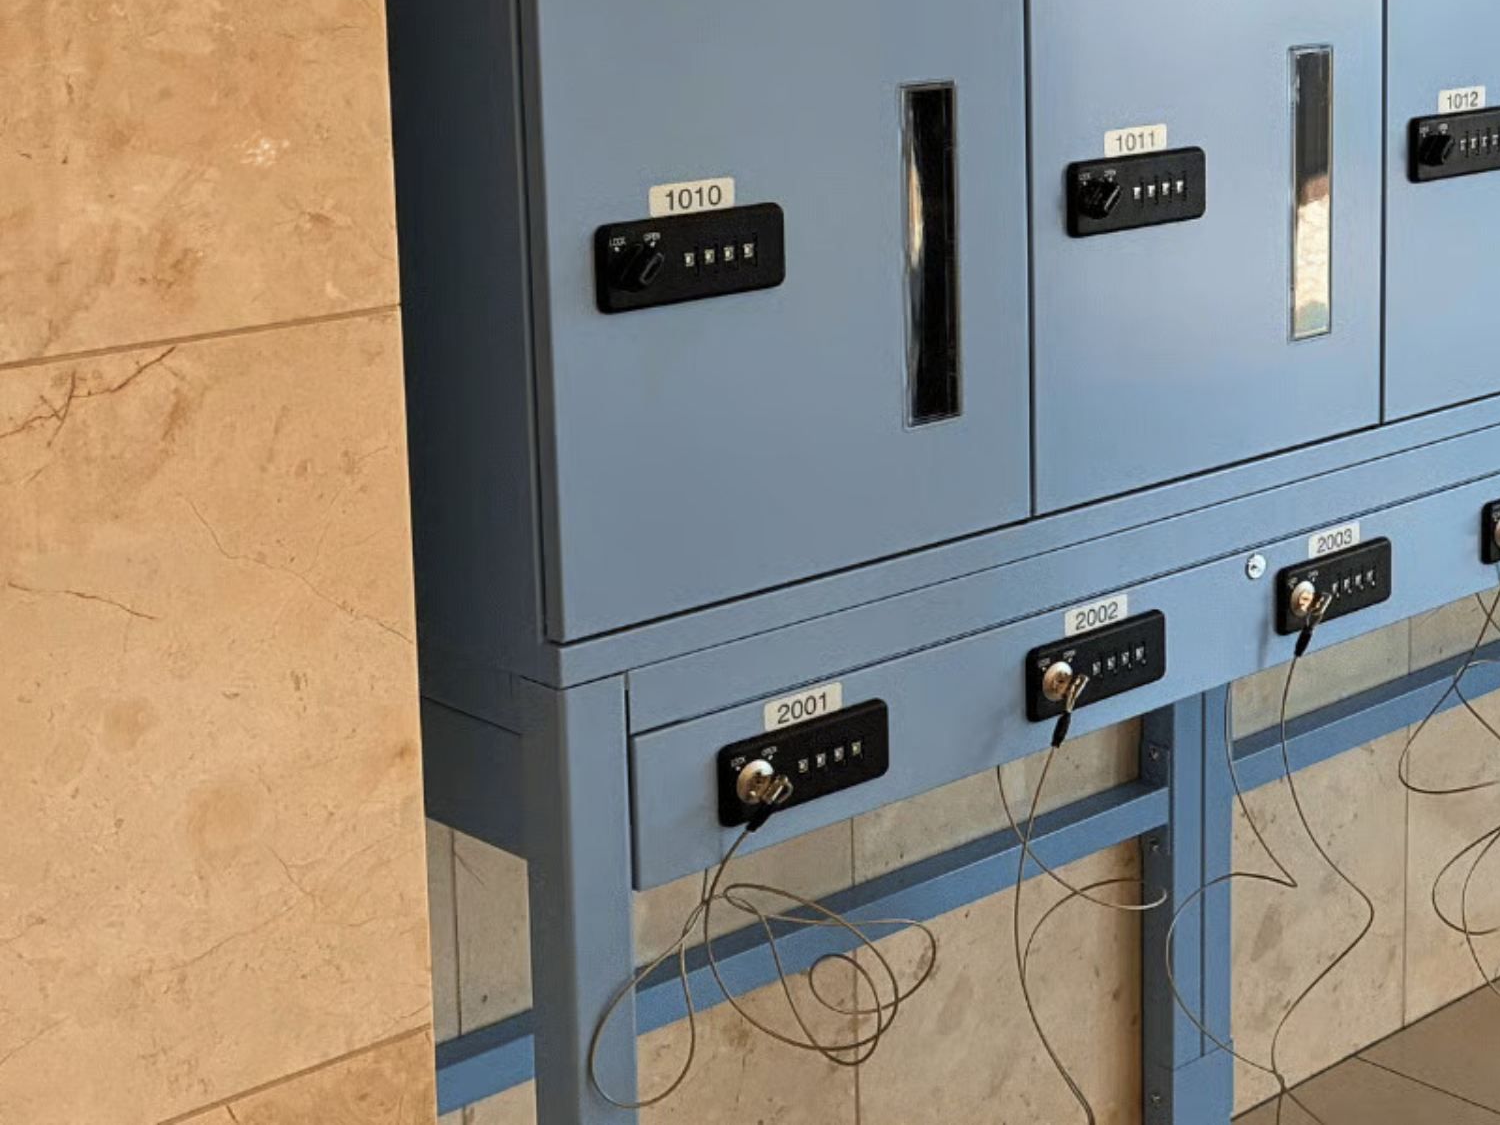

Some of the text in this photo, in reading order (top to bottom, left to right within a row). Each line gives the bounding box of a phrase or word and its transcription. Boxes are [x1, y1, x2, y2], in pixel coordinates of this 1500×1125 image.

[1446, 91, 1478, 110] 1012
[1115, 132, 1156, 152] 1011
[665, 186, 722, 210] 1010
[1317, 528, 1352, 553] 2003
[1075, 602, 1119, 630] 2002
[777, 692, 828, 725] 2001
